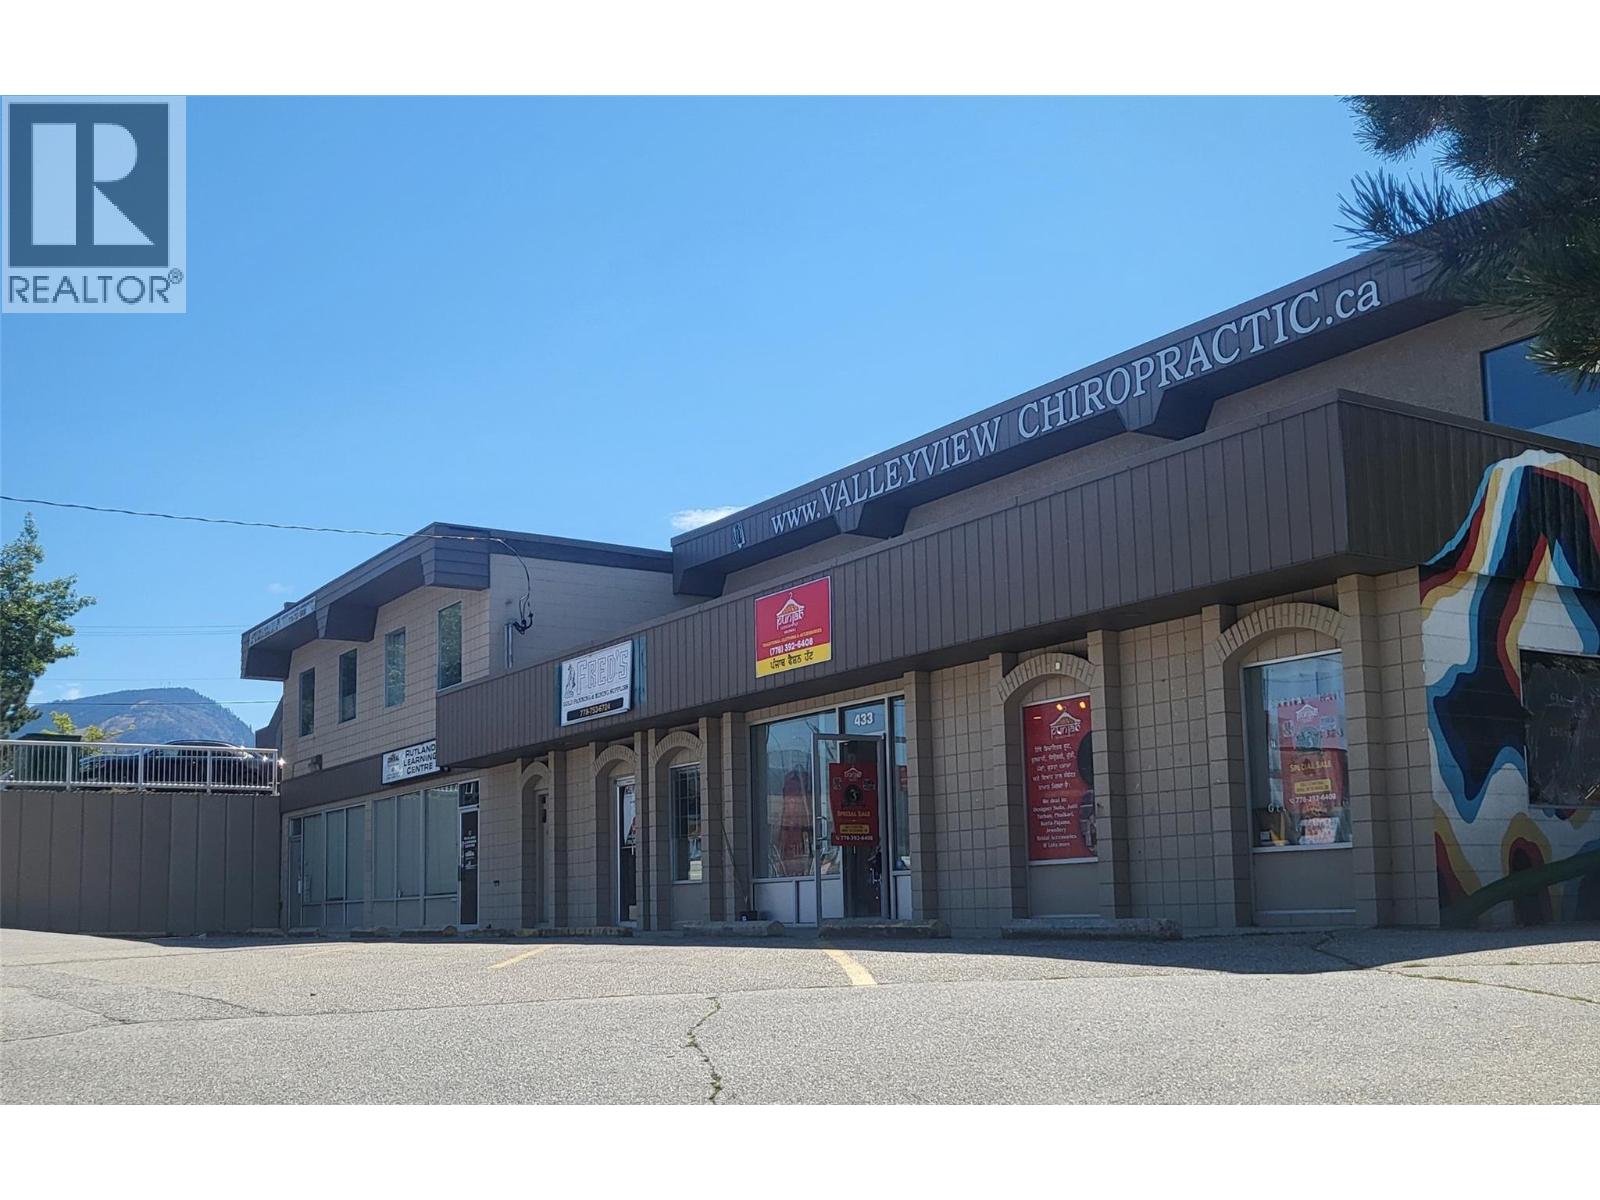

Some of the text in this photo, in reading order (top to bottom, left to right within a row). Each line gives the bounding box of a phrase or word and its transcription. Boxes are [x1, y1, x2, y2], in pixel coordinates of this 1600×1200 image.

[1018, 280, 1381, 439] CHIROPRACTIC.ca
[577, 649, 629, 696] FRED'S
[854, 712, 873, 726] 433
[404, 743, 436, 758] RUTLAND
[406, 762, 433, 775] CENTRE
